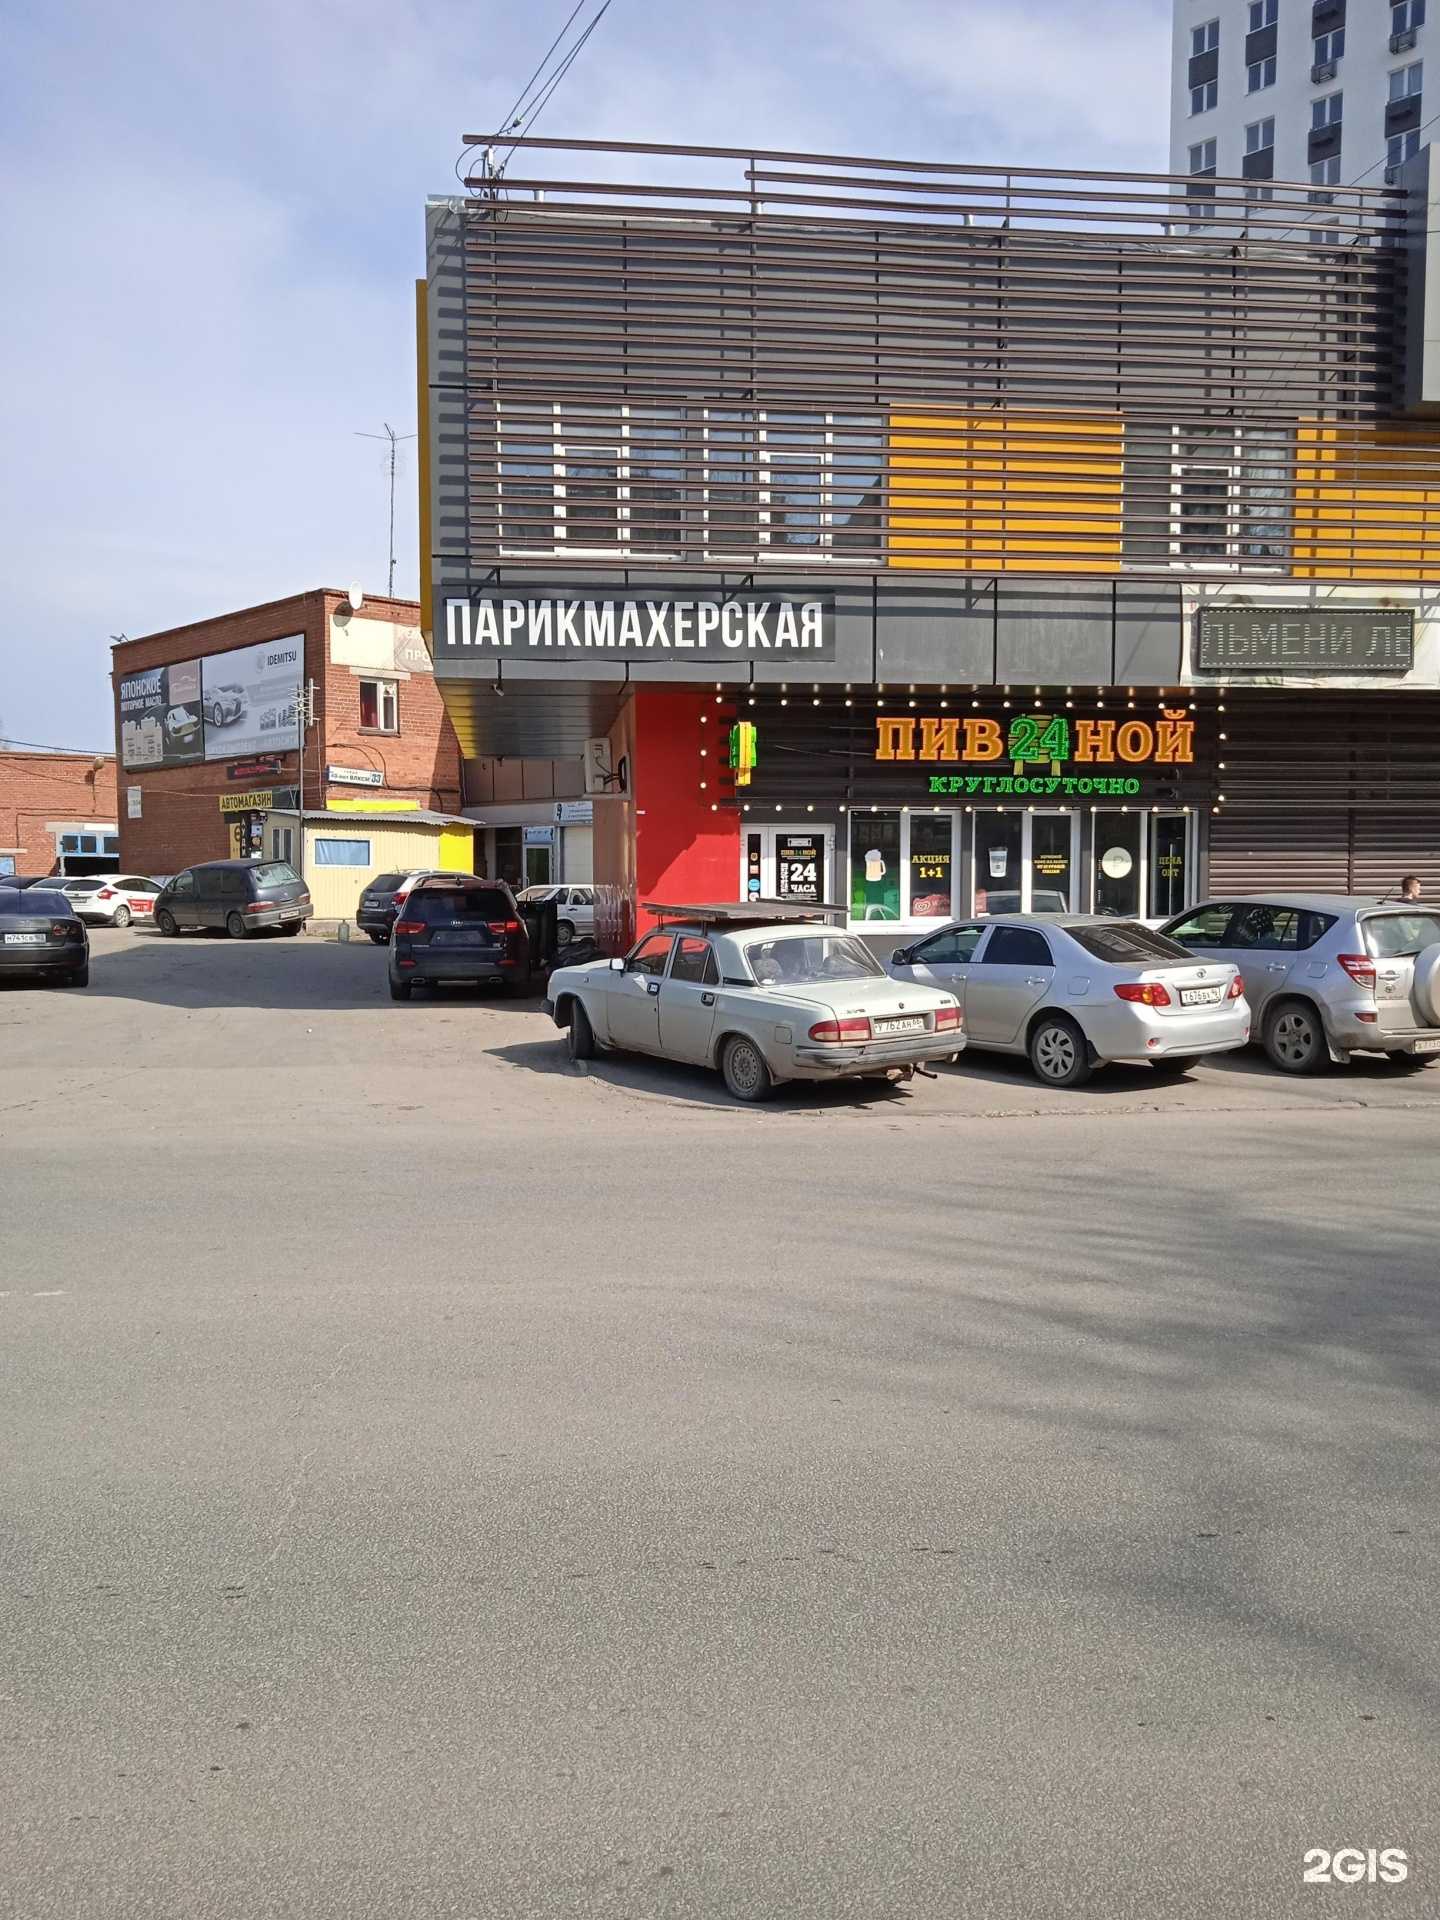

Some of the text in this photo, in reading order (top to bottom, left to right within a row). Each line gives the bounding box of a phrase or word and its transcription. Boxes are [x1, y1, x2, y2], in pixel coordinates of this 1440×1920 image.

[446, 598, 823, 648] ПАРИКМАХЕРСКАЯ
[267, 650, 297, 666] IDEMITSU
[121, 678, 162, 700] ЯПОНСКОЕ
[929, 776, 1140, 795] КРУГЛОСУТОЧНО
[222, 792, 272, 810] АВТОМАГАЗИН
[911, 855, 950, 865] АКЦИЯ
[790, 863, 817, 881] 24
[919, 867, 944, 878] 1+1
[790, 884, 817, 893] ЧАСА
